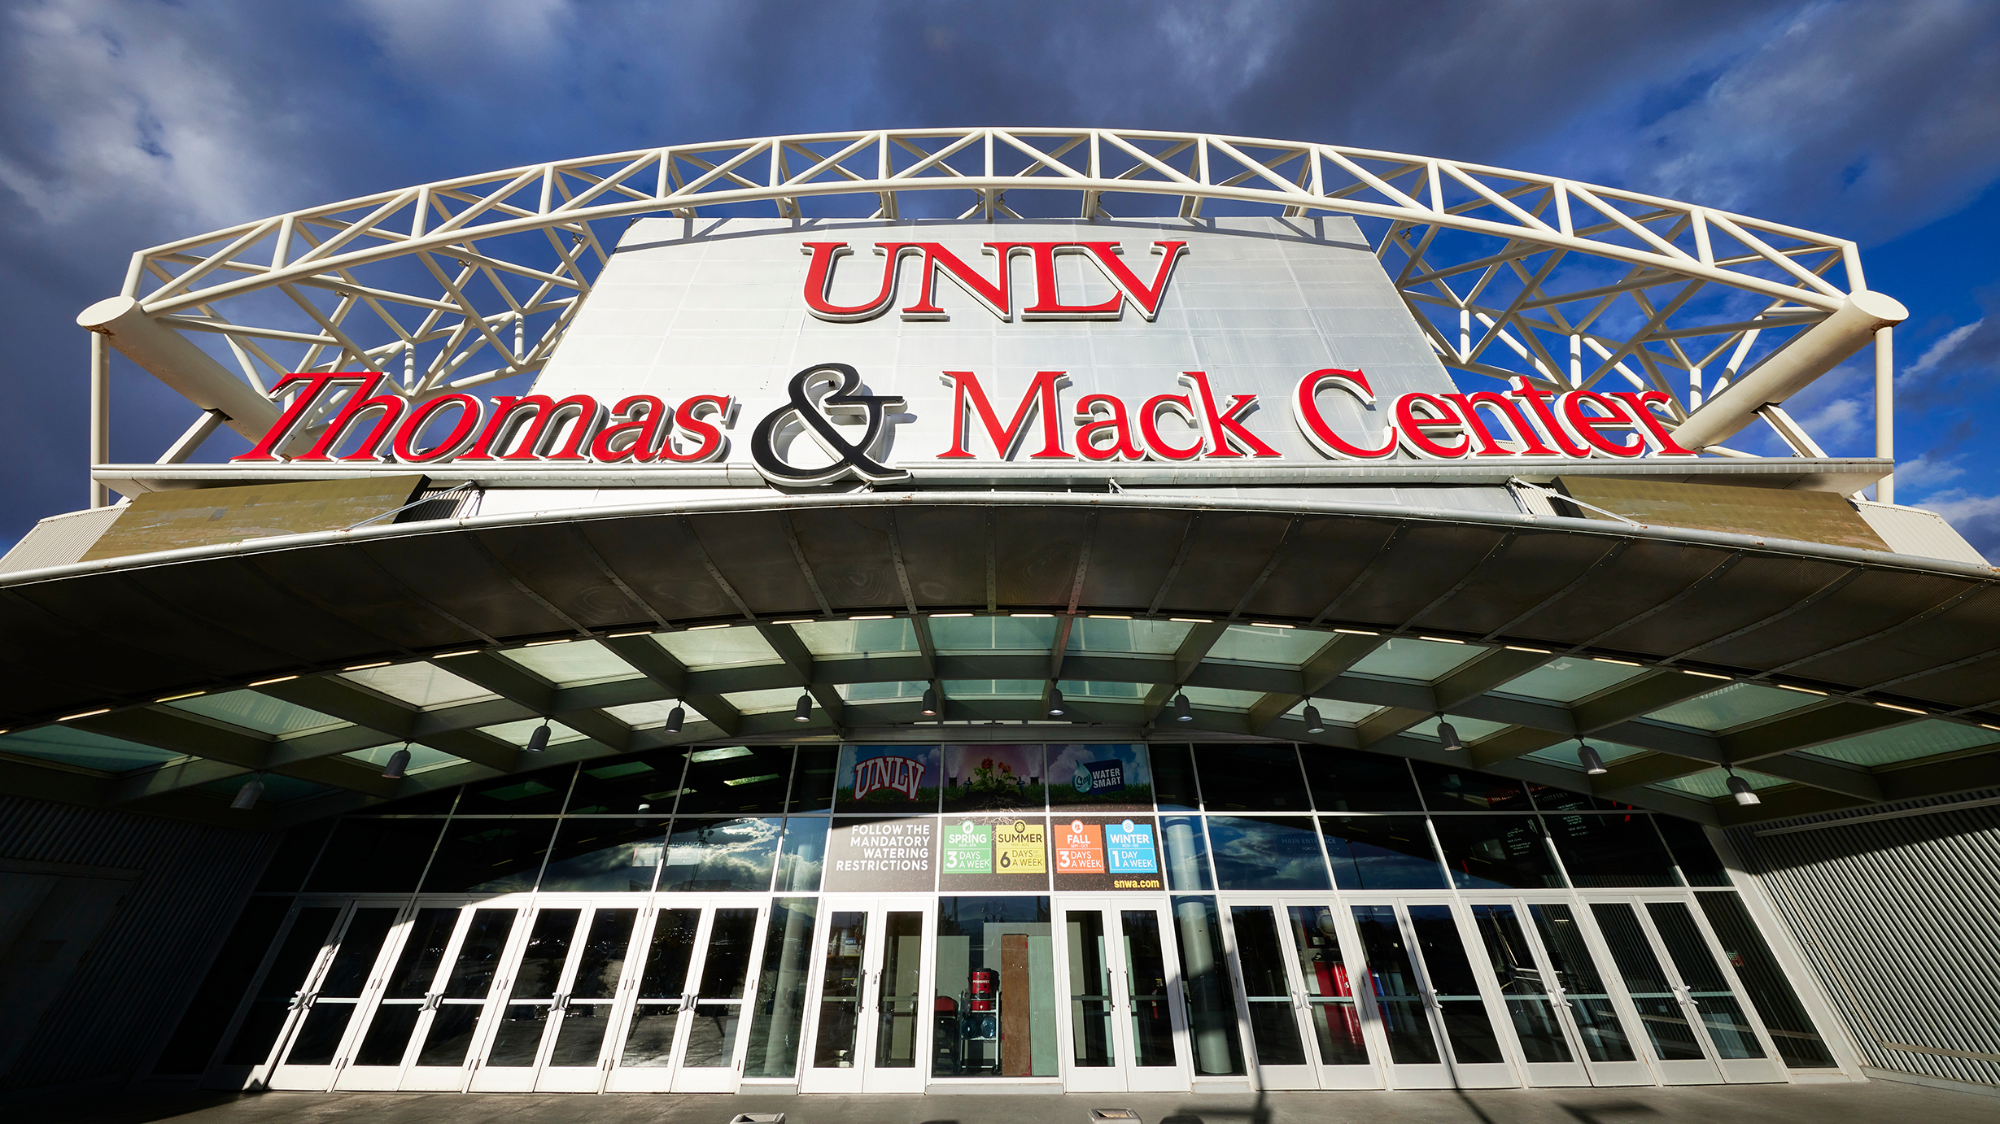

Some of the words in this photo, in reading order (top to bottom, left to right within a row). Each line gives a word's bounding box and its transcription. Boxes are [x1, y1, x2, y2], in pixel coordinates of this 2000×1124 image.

[801, 241, 1188, 322] UNLV
[230, 370, 738, 463] Thomas
[752, 362, 913, 487] &
[936, 370, 1282, 462] Mack
[1292, 368, 1699, 461] Center
[854, 756, 926, 800] UNLV
[1092, 767, 1121, 780] WATER
[1076, 773, 1091, 788] Stay
[1093, 776, 1121, 789] SMART
[852, 825, 903, 835] FOLLOW
[906, 825, 930, 835] THE
[850, 836, 930, 847] MANDATORY
[949, 834, 987, 844] SPRING
[998, 834, 1042, 843] SUMMER
[1067, 834, 1091, 844] FALL
[1109, 834, 1150, 844] WINTER
[863, 848, 929, 859] WATERING
[959, 851, 981, 860] DAYS
[1012, 850, 1033, 858] DAYS
[1070, 851, 1092, 859] DAYS
[1112, 850, 1120, 867] 1
[1121, 851, 1138, 859] DAY
[946, 851, 958, 868] 3
[959, 860, 966, 868] A
[966, 859, 990, 868] WEEK
[1000, 851, 1011, 868] 6
[1012, 859, 1018, 867] A
[1019, 859, 1043, 867] WEEK
[1059, 851, 1070, 868] 3
[1071, 860, 1078, 868] A
[1078, 860, 1102, 868] WEEK
[1123, 860, 1129, 868] A
[1129, 859, 1153, 868] WEEK
[836, 860, 928, 871] RESTRICTIONS
[1114, 880, 1160, 889] snwa.com
